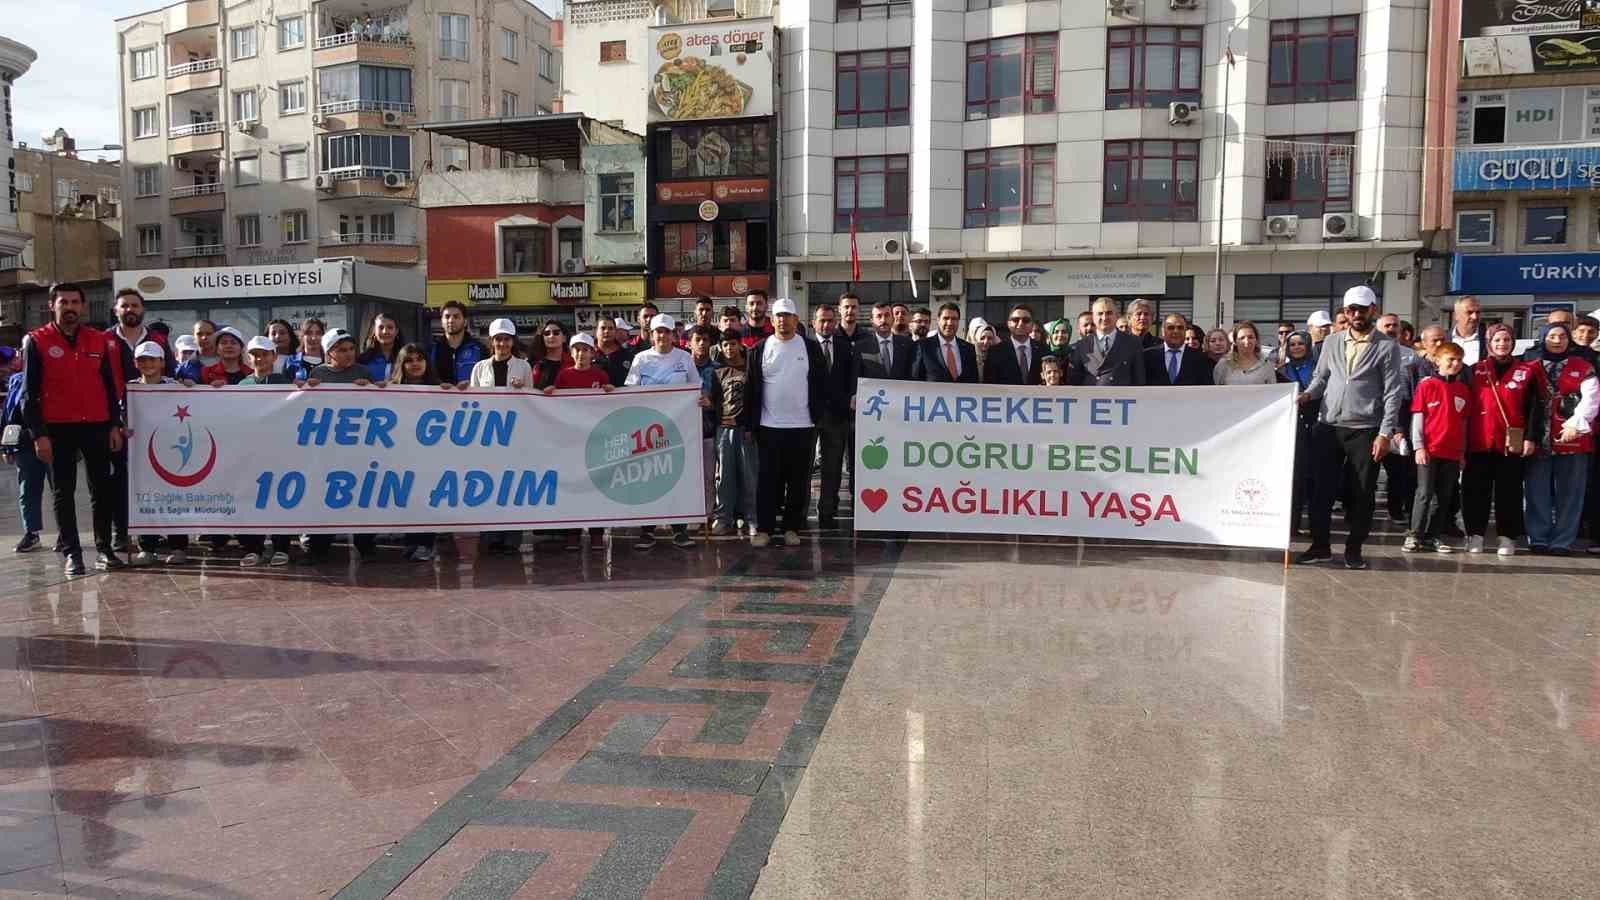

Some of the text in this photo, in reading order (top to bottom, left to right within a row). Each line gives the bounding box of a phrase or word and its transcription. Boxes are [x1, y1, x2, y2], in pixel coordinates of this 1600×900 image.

[723, 30, 764, 43] döner
[1516, 109, 1553, 122] HDI
[1480, 157, 1568, 181] GÜÇLÜ
[193, 269, 322, 289] KİLİS BELEDİYESİ
[1010, 275, 1039, 288] SGK
[1520, 262, 1600, 279] TÜRKİY
[468, 283, 505, 300] Marshall
[550, 281, 588, 298] Marshall
[903, 396, 1136, 426] HAREKET ET
[297, 400, 517, 449] HER GÜN
[631, 424, 664, 454] 10
[903, 434, 1199, 475] DOĞRU BESLEN
[255, 460, 558, 510] 10 BİN ADIM
[902, 480, 1181, 527] SAĞLIKLI YAŞA
